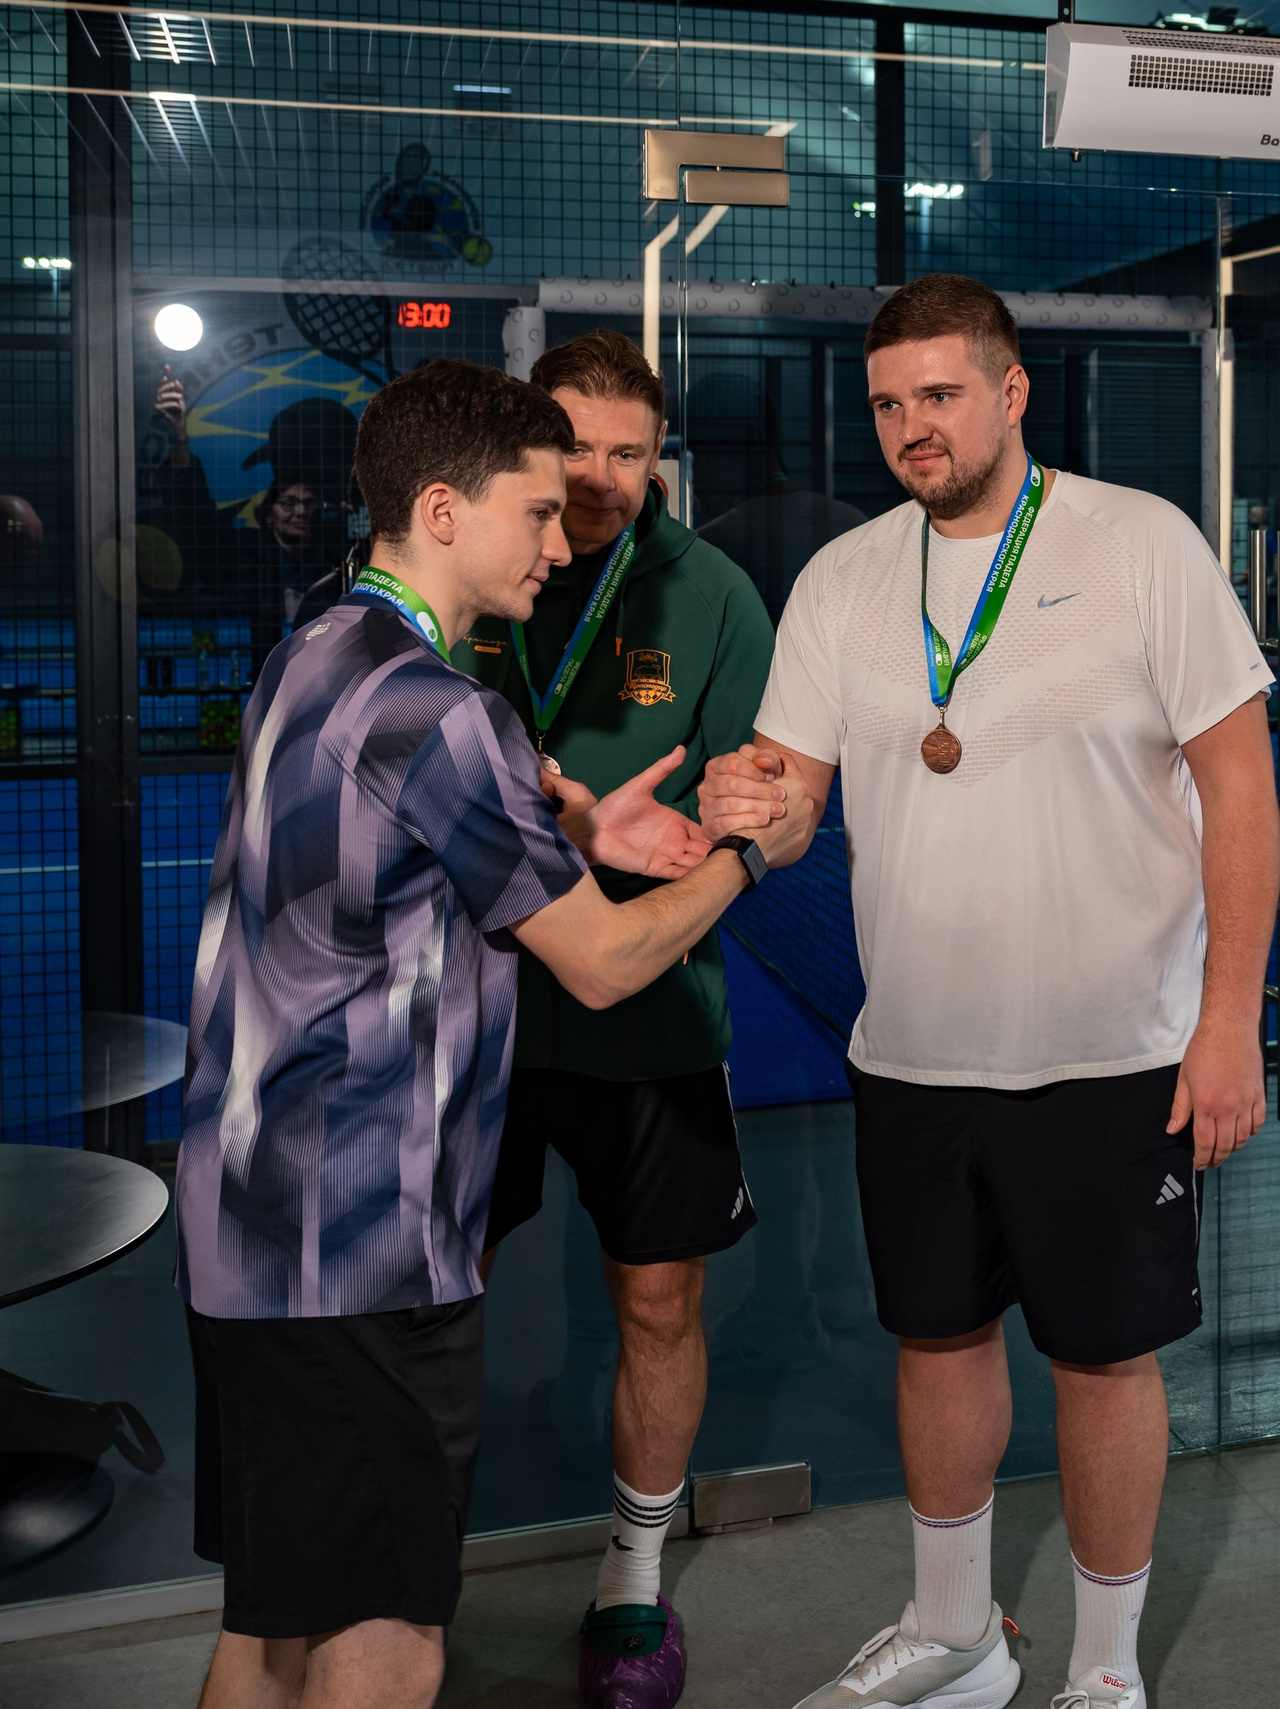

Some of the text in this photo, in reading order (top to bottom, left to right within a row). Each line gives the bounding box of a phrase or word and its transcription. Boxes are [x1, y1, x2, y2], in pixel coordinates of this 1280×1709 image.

[366, 571, 404, 594] ПАДЕЛА
[583, 531, 630, 623] КРАСНОДАРСКОГО КРАЯ
[596, 541, 635, 619] ФЕДЕРАЦИЯ ПАДЕЛА
[986, 494, 1029, 593] КРАСНОДАРСКОГО КРАЯ
[998, 506, 1035, 588] ФЕДЕРАЦИЯ ПАДЕЛА
[376, 588, 405, 606] КРАЯ
[1102, 1674, 1127, 1690] Wilson
